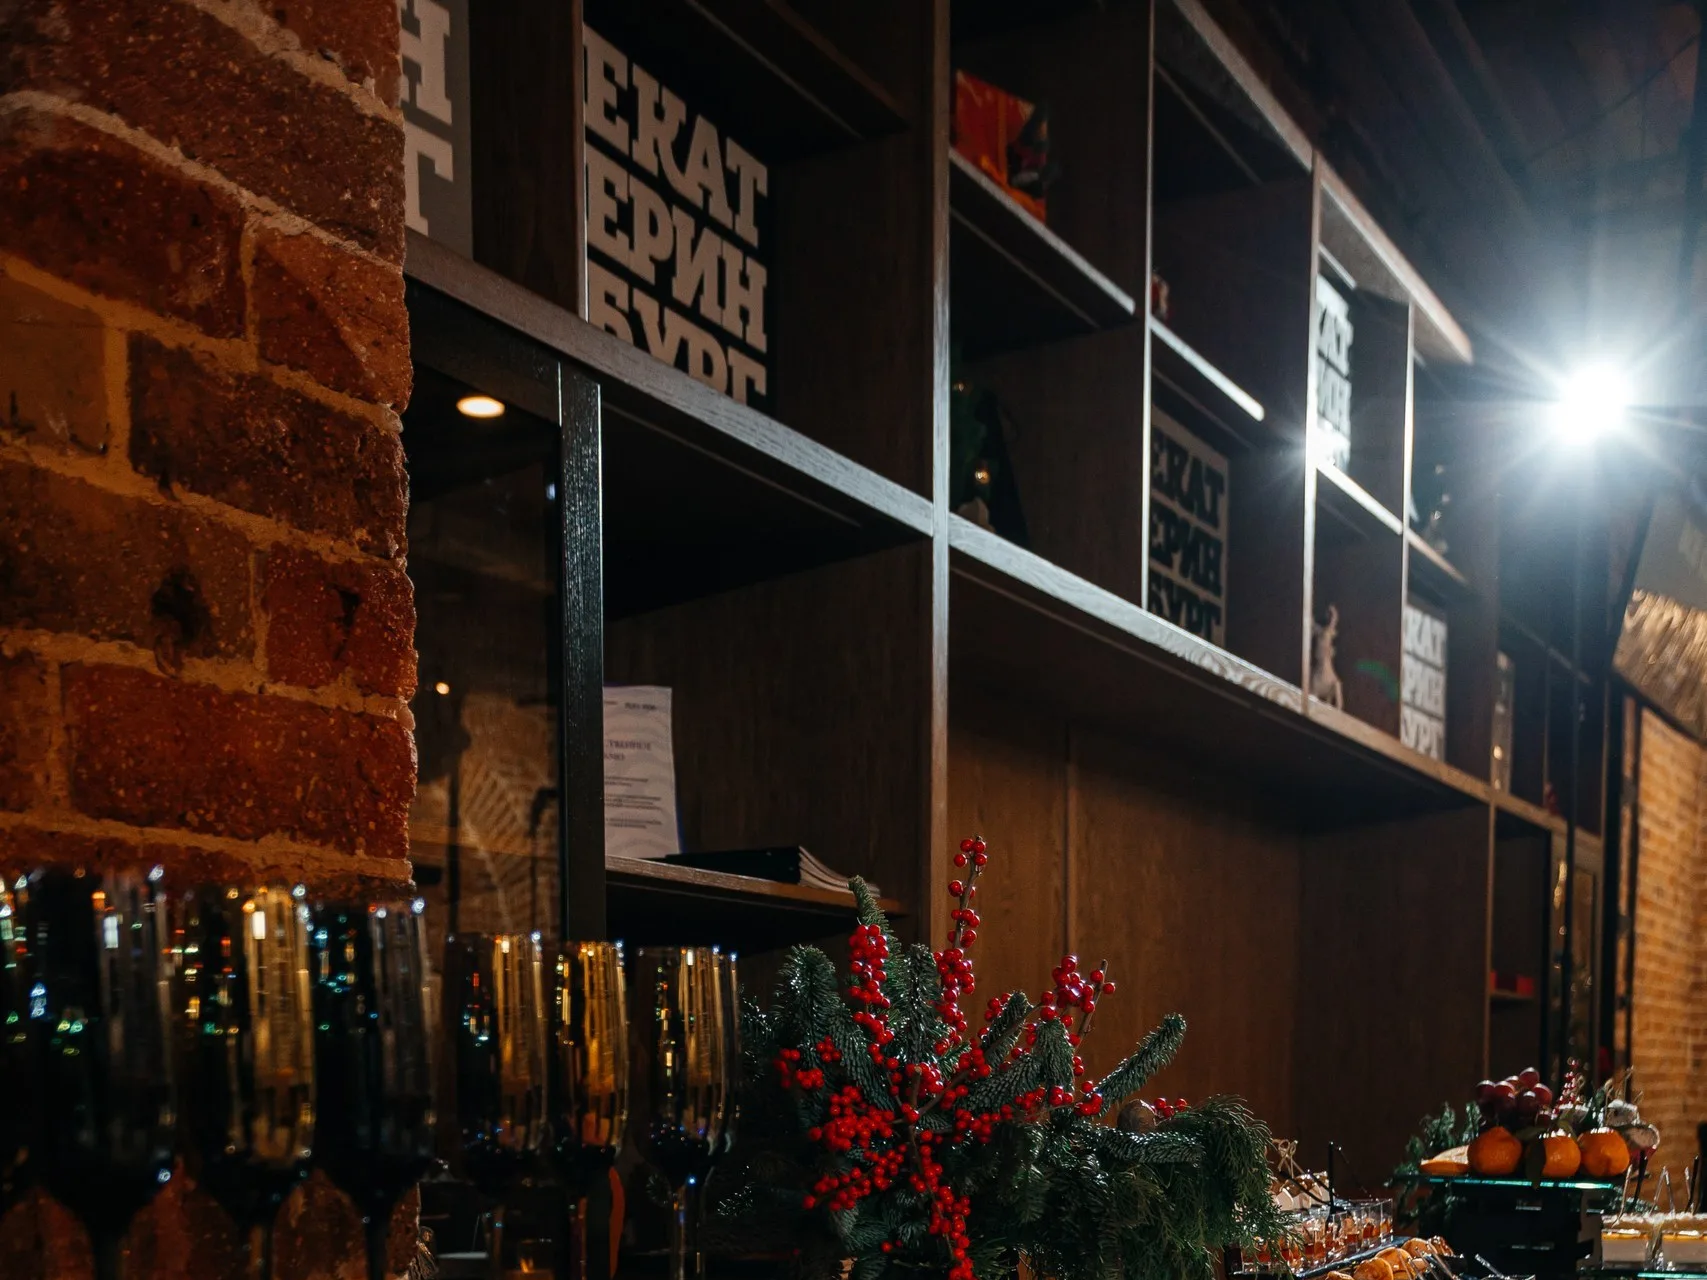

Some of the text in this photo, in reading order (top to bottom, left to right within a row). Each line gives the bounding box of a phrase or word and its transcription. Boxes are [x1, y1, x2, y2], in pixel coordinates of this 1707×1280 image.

[583, 22, 768, 249] ЕКАТ
[585, 141, 767, 354] ЕРИН
[1402, 604, 1448, 672] КАТ
[1401, 703, 1445, 760] УРГ
